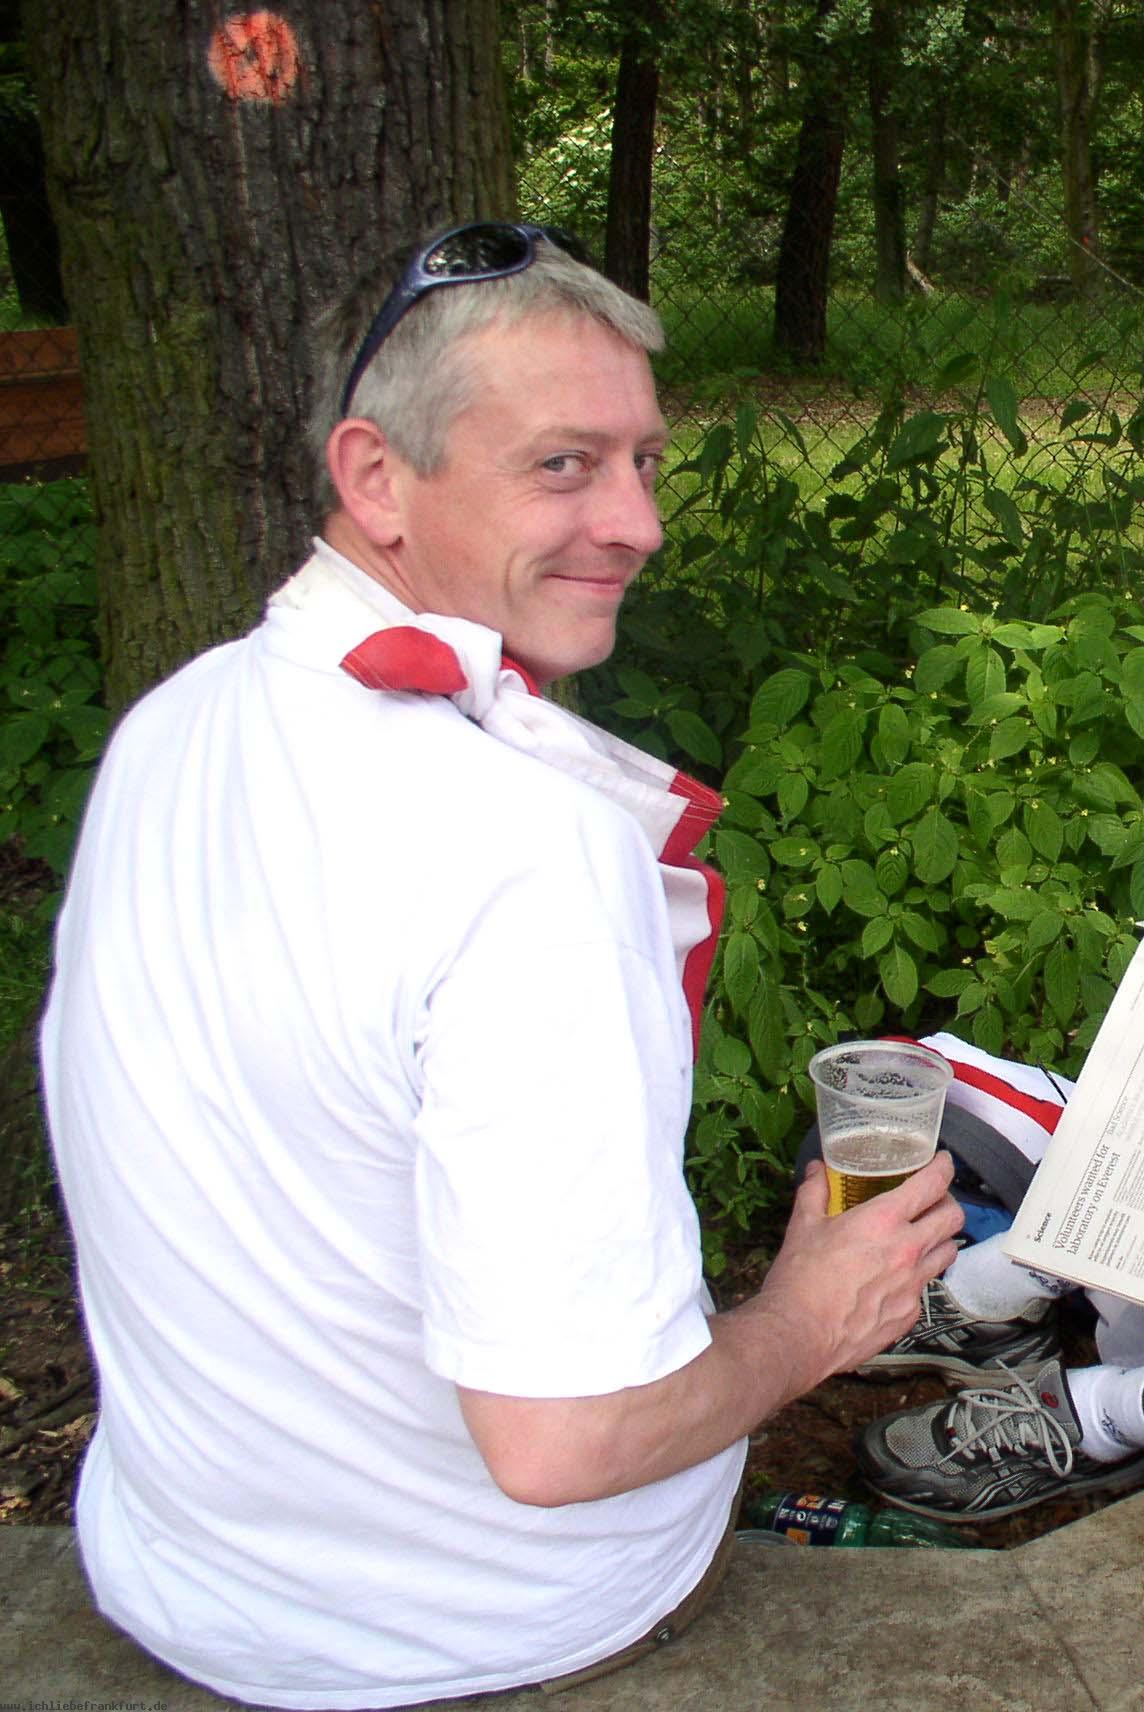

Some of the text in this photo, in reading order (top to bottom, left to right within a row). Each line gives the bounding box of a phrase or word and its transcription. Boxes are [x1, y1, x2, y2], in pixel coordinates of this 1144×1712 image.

[1097, 1152, 1121, 1190] Everest
[1052, 1144, 1111, 1249] Volunteers wanted for
[1092, 1188, 1104, 1203] on
[1034, 1212, 1052, 1243] Science
[1066, 1202, 1099, 1255] laboratory
